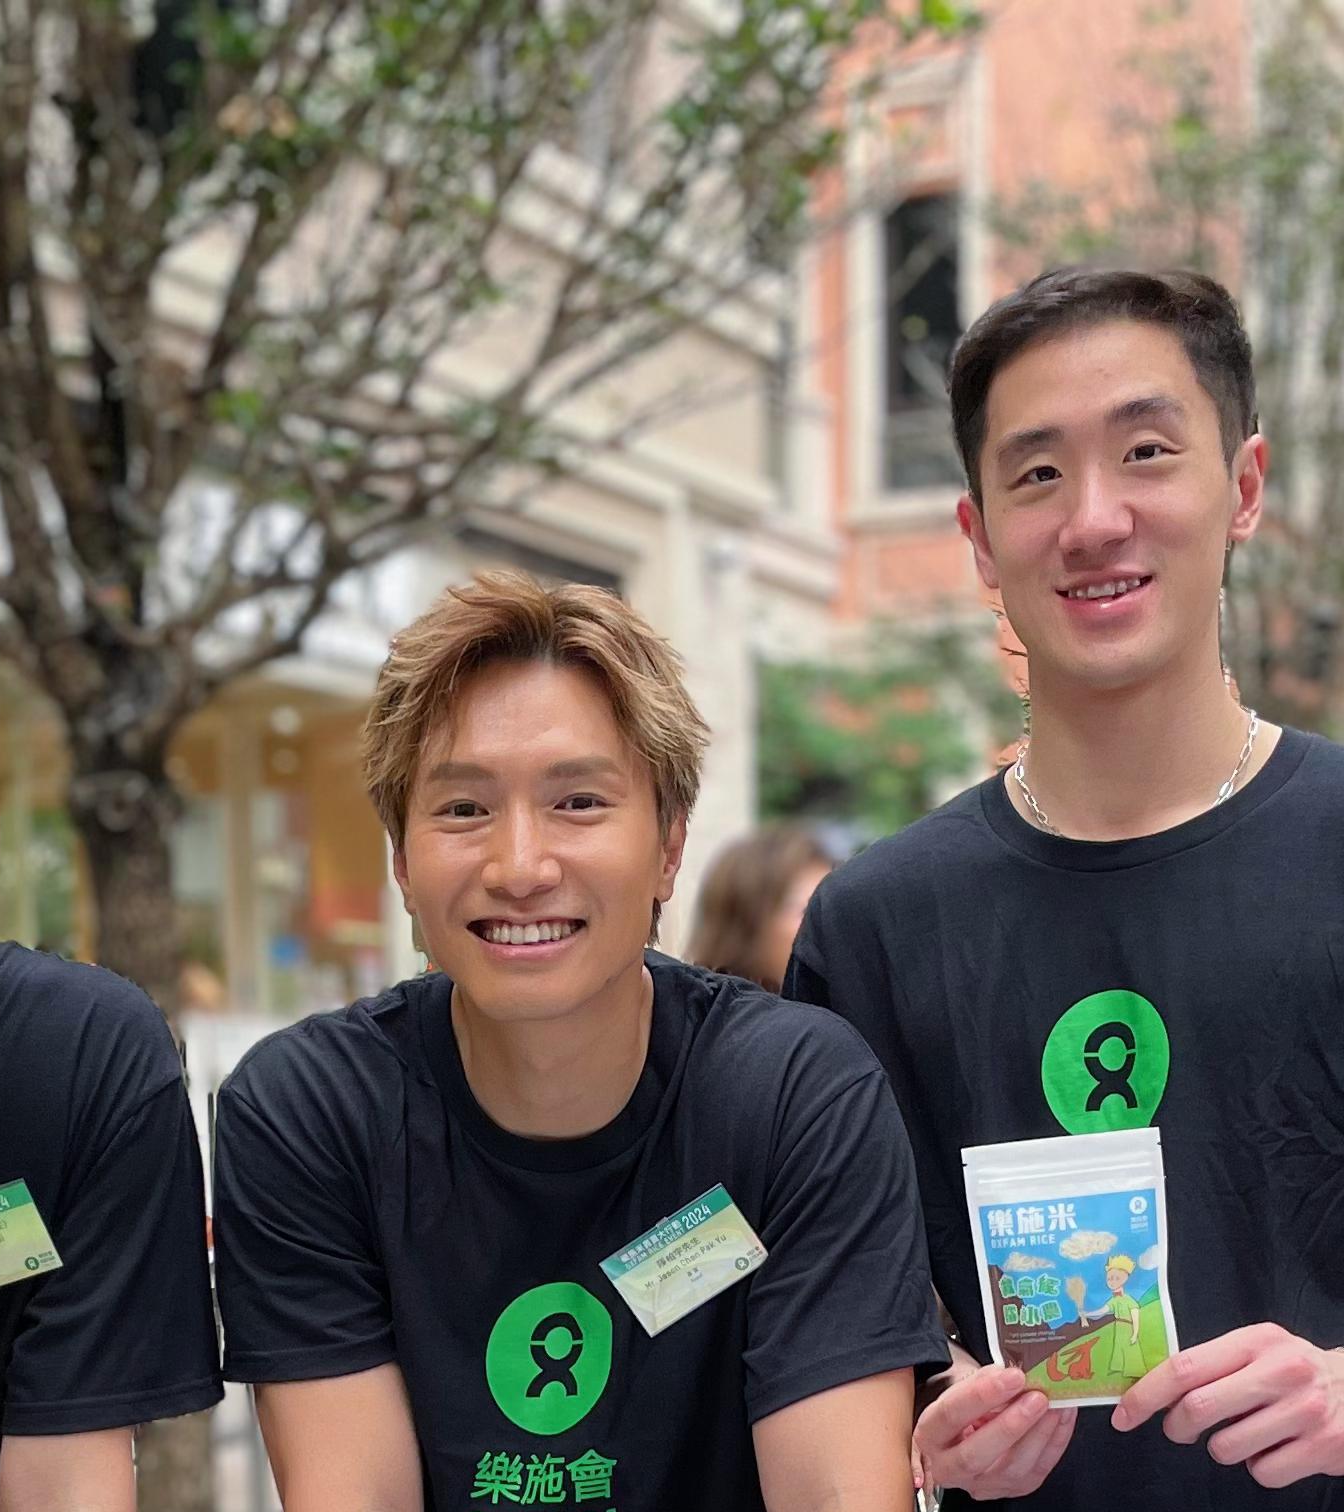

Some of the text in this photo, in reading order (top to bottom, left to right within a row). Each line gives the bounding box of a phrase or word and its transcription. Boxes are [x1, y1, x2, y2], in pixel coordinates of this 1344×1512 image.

[681, 1204, 713, 1231] 2024
[987, 1203, 1078, 1237] 樂施米
[991, 1234, 1056, 1249] OXFAM RICE
[470, 1449, 617, 1506] 樂施會
